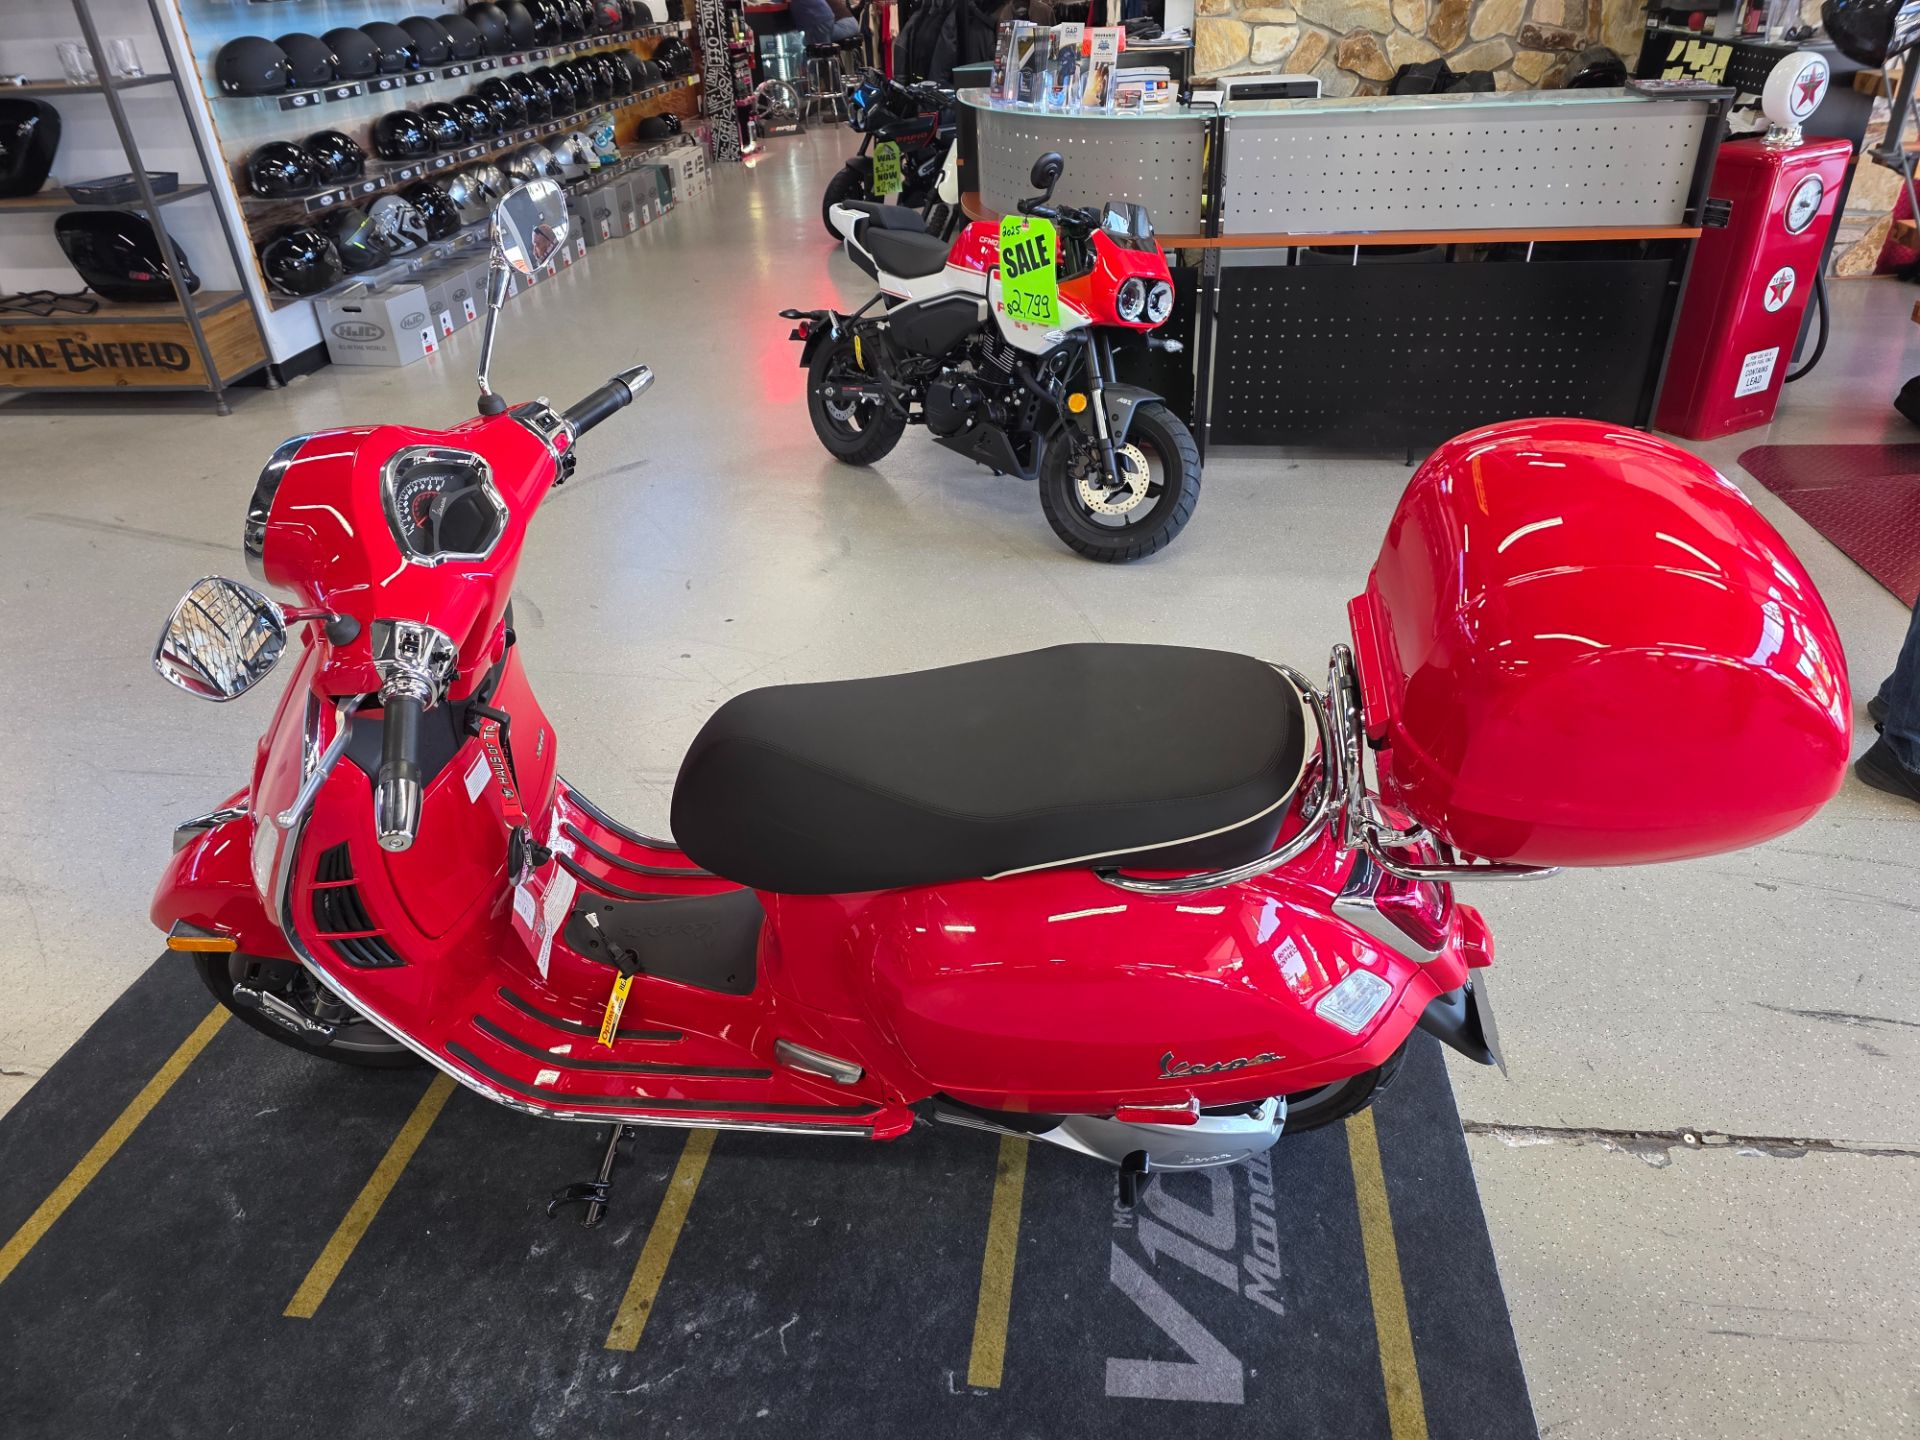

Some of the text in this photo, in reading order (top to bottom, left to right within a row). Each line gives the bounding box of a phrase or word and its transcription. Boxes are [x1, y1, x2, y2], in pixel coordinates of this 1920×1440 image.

[702, 1, 721, 64] Muc-Off
[877, 171, 897, 181] NOW
[979, 236, 999, 247] CFMO
[1002, 225, 1021, 237] 2025
[1002, 234, 1051, 278] SALE
[1007, 289, 1051, 319] $2,799
[338, 325, 378, 338] HJC
[0, 334, 190, 372] YAL ENFIELD
[1746, 375, 1763, 387] LEAD
[1158, 1050, 1286, 1080] Vespa
[1105, 1166, 1245, 1405] V10
